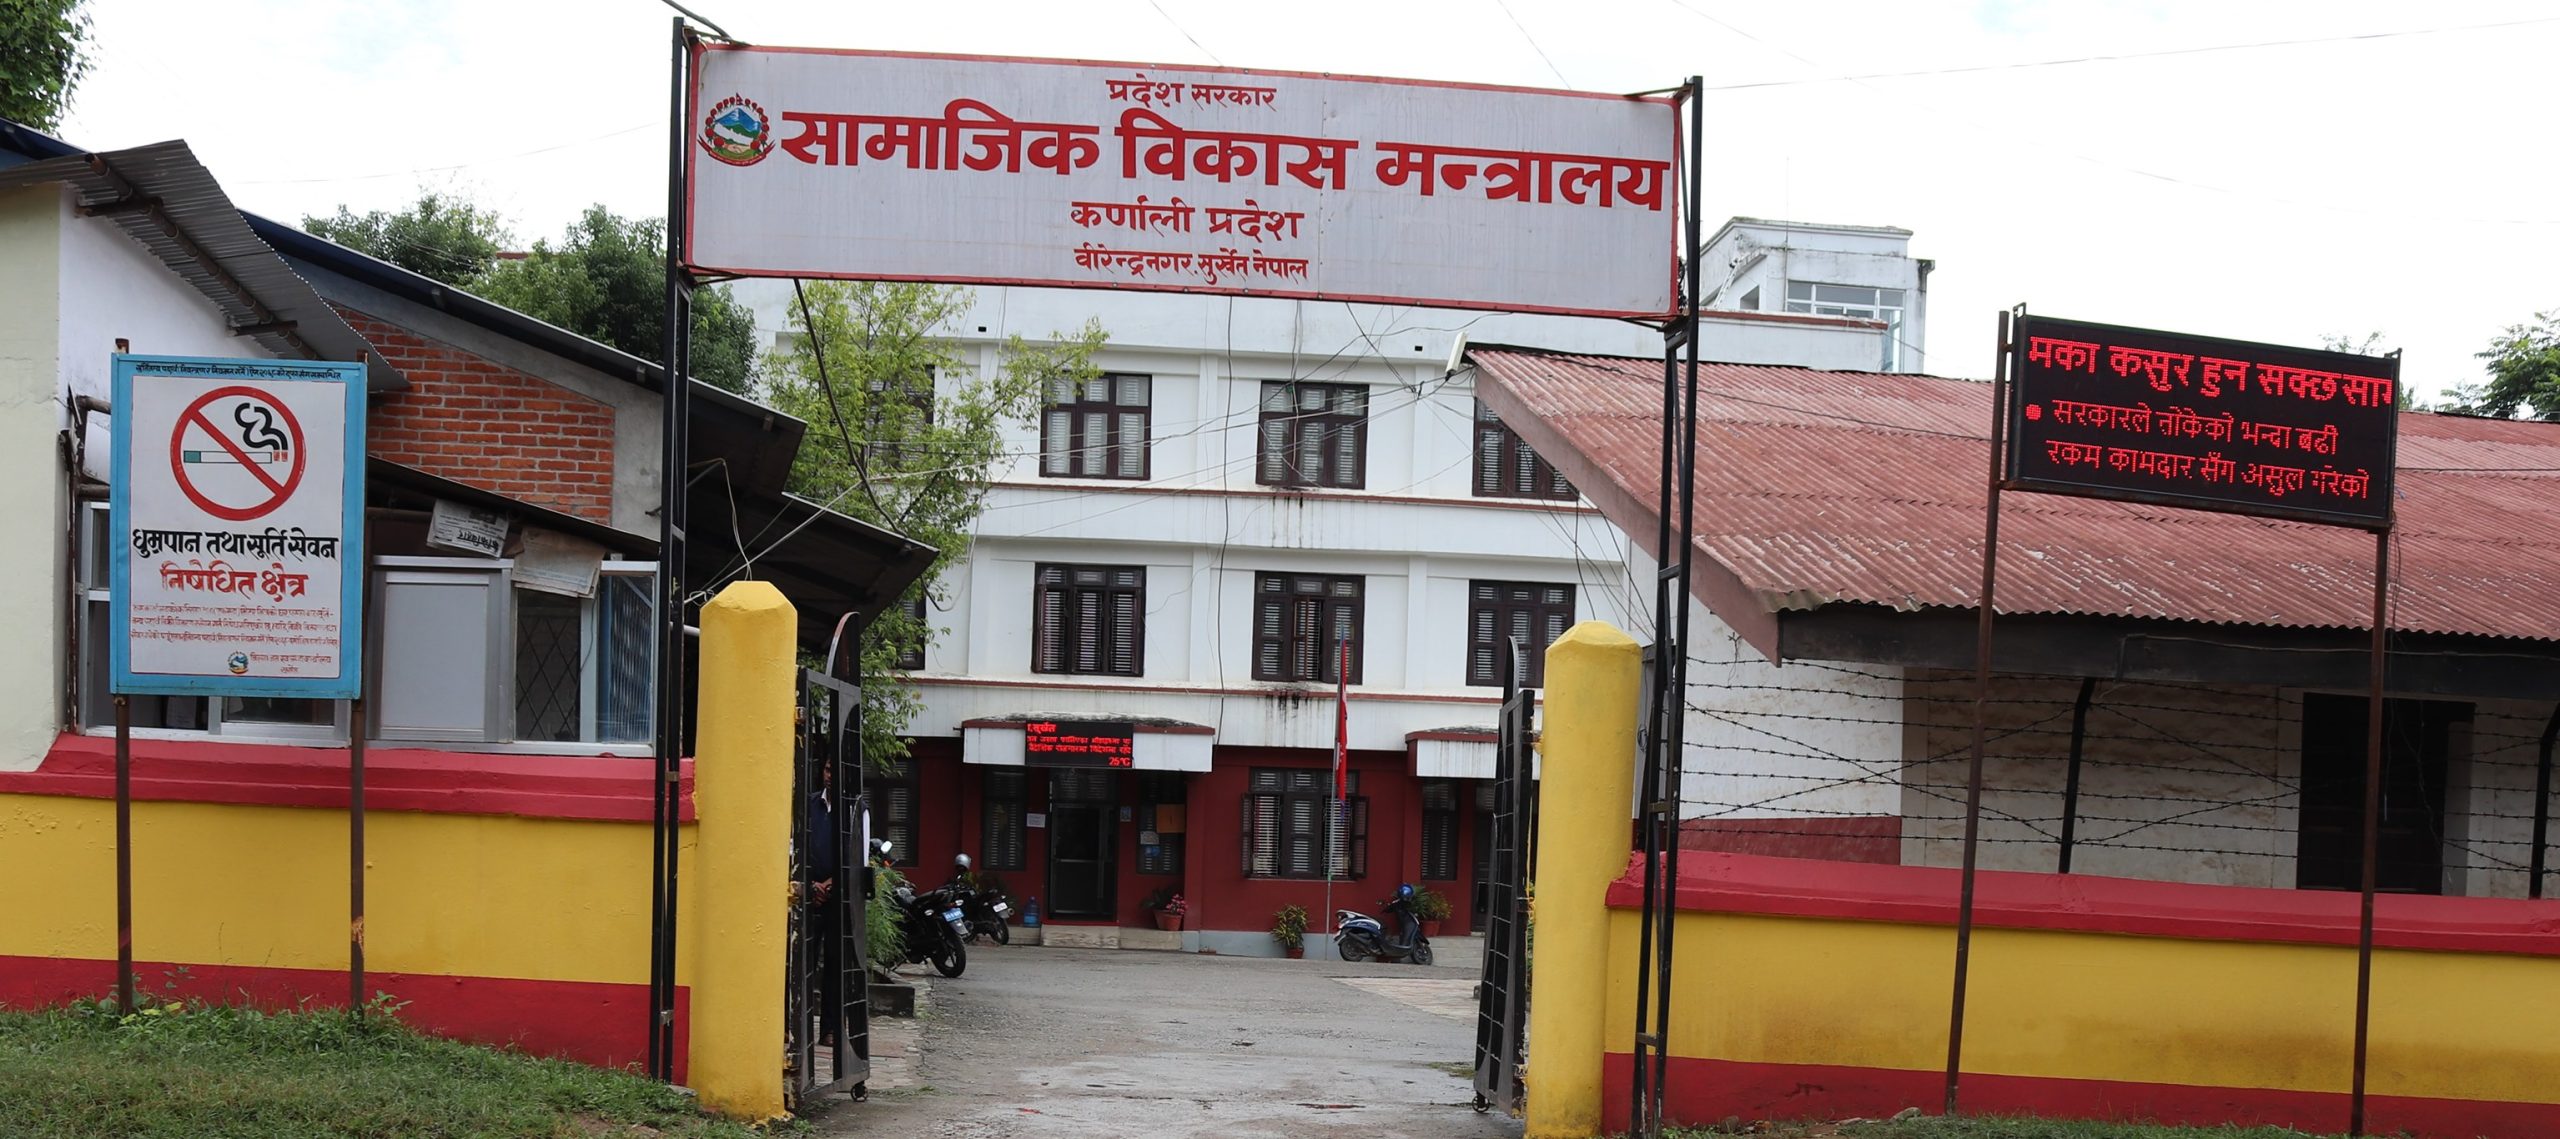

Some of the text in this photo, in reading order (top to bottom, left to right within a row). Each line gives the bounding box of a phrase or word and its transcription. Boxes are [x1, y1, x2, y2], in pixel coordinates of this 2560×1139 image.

[1106, 73, 1277, 112] प्रदेश सरकार
[780, 98, 1671, 212] सामाजिक विकास मन्त्रालय
[1071, 194, 1305, 243] कर्णाली प्रदेश
[1252, 249, 1309, 284] नेपाल
[2028, 336, 2101, 374] मका
[2108, 345, 2195, 392] कसुर
[2200, 356, 2251, 398] हुन
[2051, 399, 2339, 455] सरकारले तोकेको भन्दा बढी
[2046, 439, 2103, 469] रकम
[2107, 446, 2196, 480] कामदार
[2240, 463, 2306, 497] असुल
[204, 531, 246, 559] तथा
[287, 526, 339, 562] सेवन
[160, 559, 309, 602] निषेधित क्षेत्र
